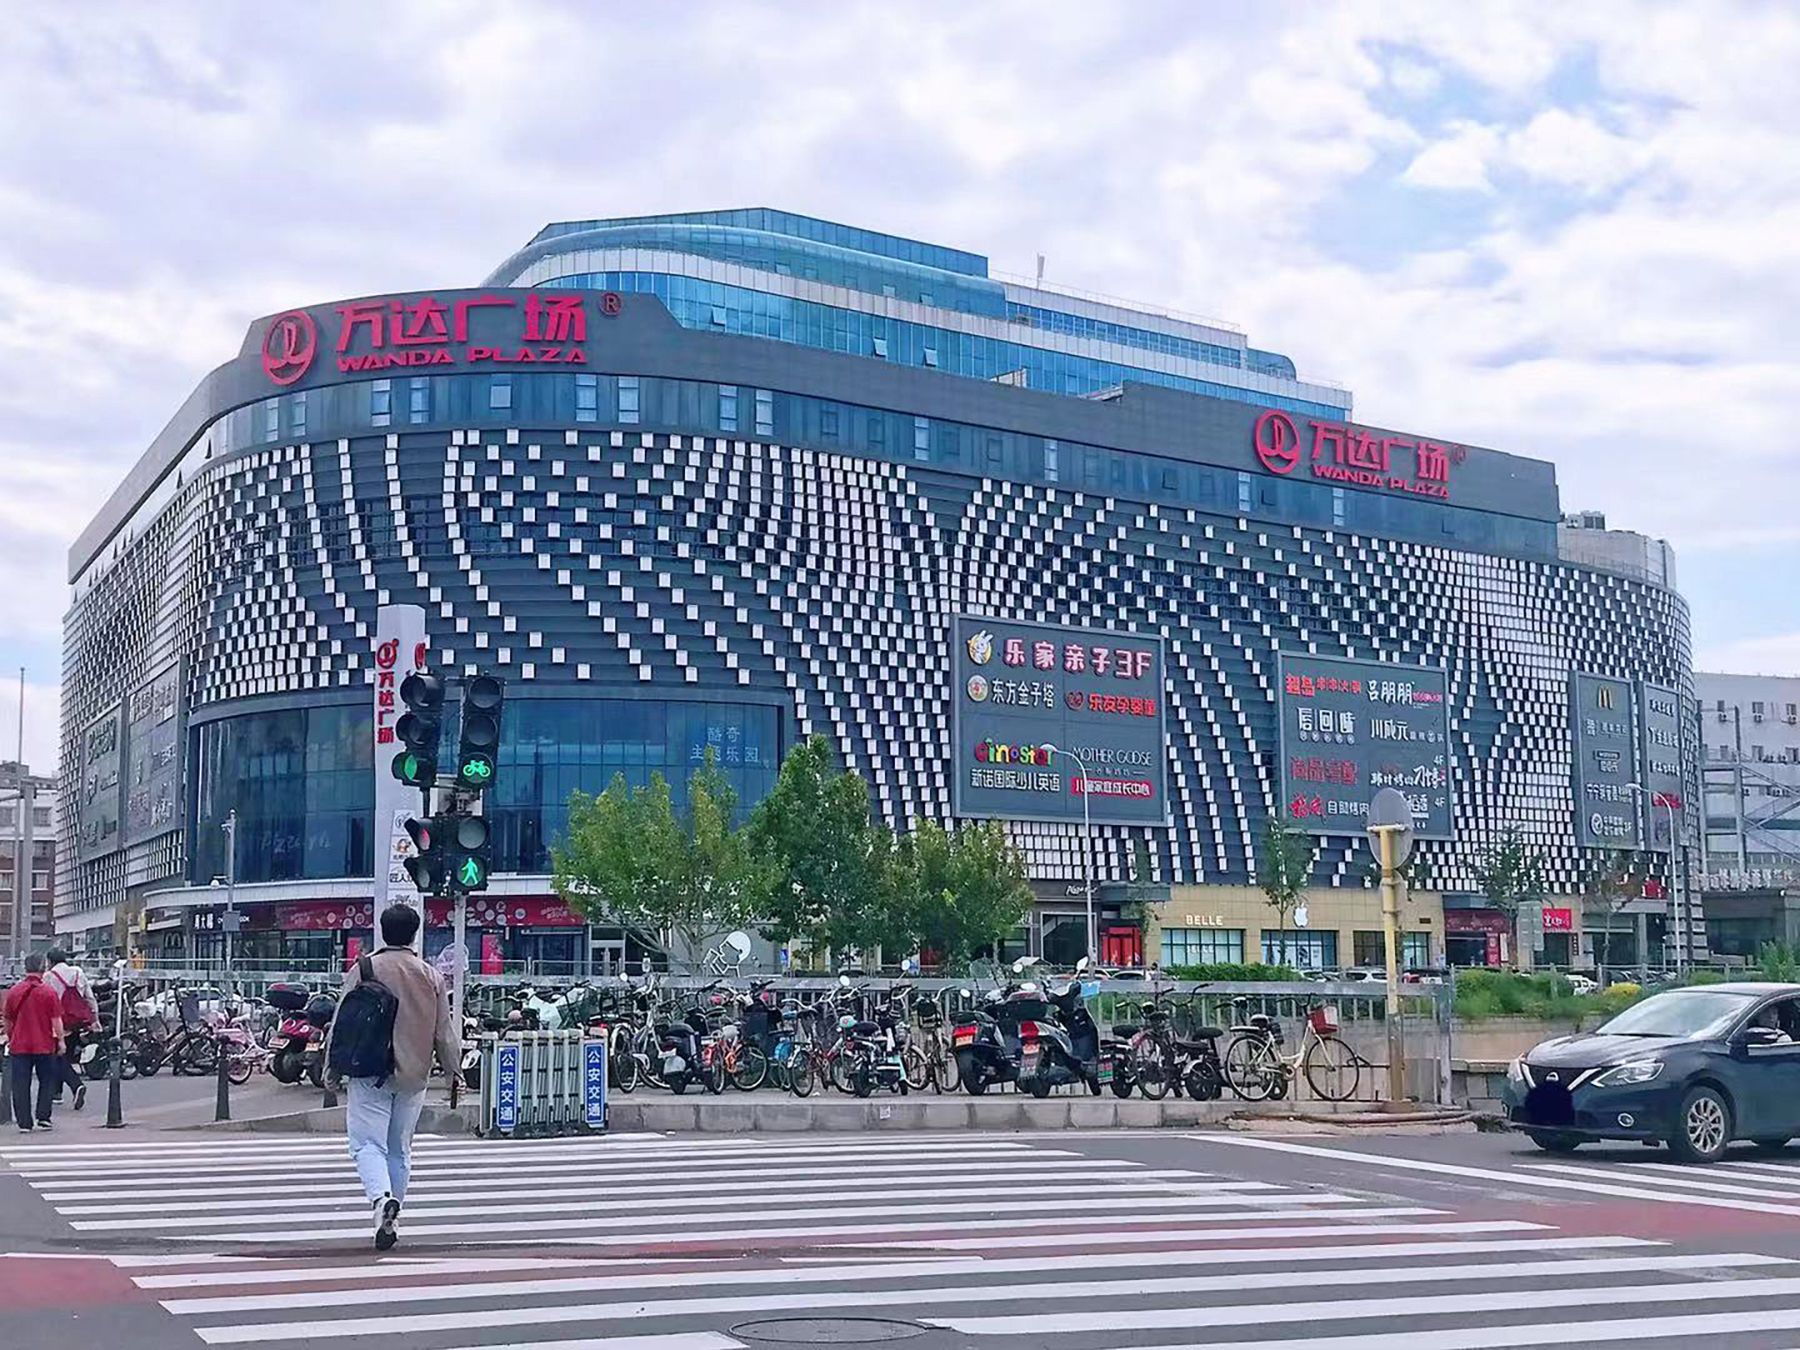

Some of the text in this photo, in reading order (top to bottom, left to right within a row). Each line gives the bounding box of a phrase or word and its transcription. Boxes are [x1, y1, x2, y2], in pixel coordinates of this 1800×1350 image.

[337, 293, 588, 353] 万达广场
[338, 346, 588, 373] WANDA PLAZA
[1309, 420, 1449, 483] 万达广场
[1312, 463, 1449, 500] WANDA PLAZA
[991, 678, 1054, 708] 东方金子塔
[1088, 693, 1156, 717] 乐友孕婴童
[707, 727, 740, 742] 酷奇
[1116, 750, 1152, 766] GOOSE
[971, 769, 1060, 792] 新诺国际少儿英语
[1327, 800, 1370, 816] 自助烤肉
[1186, 914, 1223, 926] BELLE
[501, 1053, 515, 1121] 公安交通
[588, 1050, 601, 1117] 公安交通
